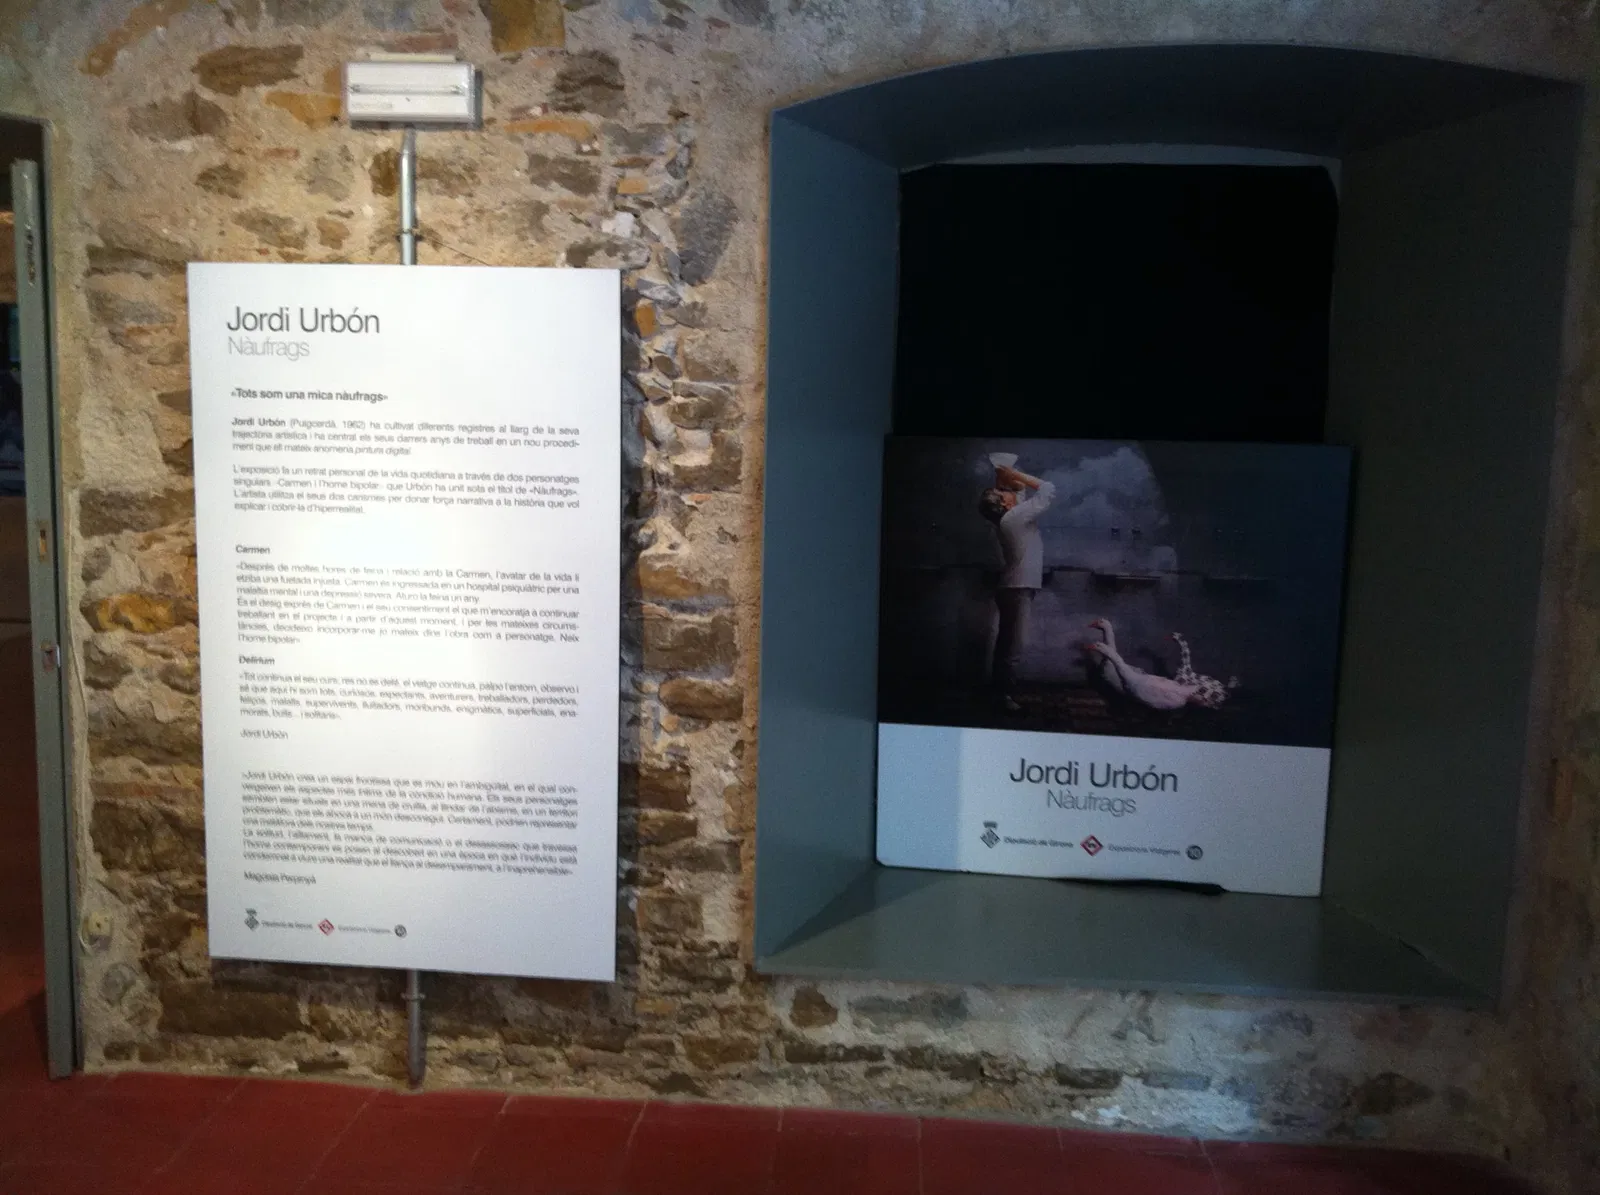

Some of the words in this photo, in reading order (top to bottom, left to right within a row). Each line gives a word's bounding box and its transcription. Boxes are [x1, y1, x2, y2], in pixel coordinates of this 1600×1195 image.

[227, 306, 290, 332] Jordi
[299, 307, 380, 333] Urbón
[227, 336, 310, 361] Nàufrags
[260, 390, 283, 399] som
[285, 390, 305, 400] una
[307, 389, 333, 400] mica
[230, 416, 255, 426] Jordi
[257, 417, 286, 427] Urbón
[457, 423, 496, 435] registres
[509, 424, 529, 436] llarg
[558, 427, 580, 435] seva
[429, 436, 451, 446] anys
[327, 467, 366, 479] personal
[389, 469, 408, 478] vida
[464, 471, 491, 481] través
[506, 472, 524, 482] dos
[524, 473, 580, 486] personatges
[385, 483, 403, 492] que
[546, 500, 564, 510] que
[566, 499, 580, 508] vol
[234, 544, 271, 554] Carmen
[237, 655, 275, 665] Delirium
[1009, 758, 1079, 786] Jordi
[1090, 762, 1178, 792] Urbón
[1047, 789, 1137, 817] Nàufrags
